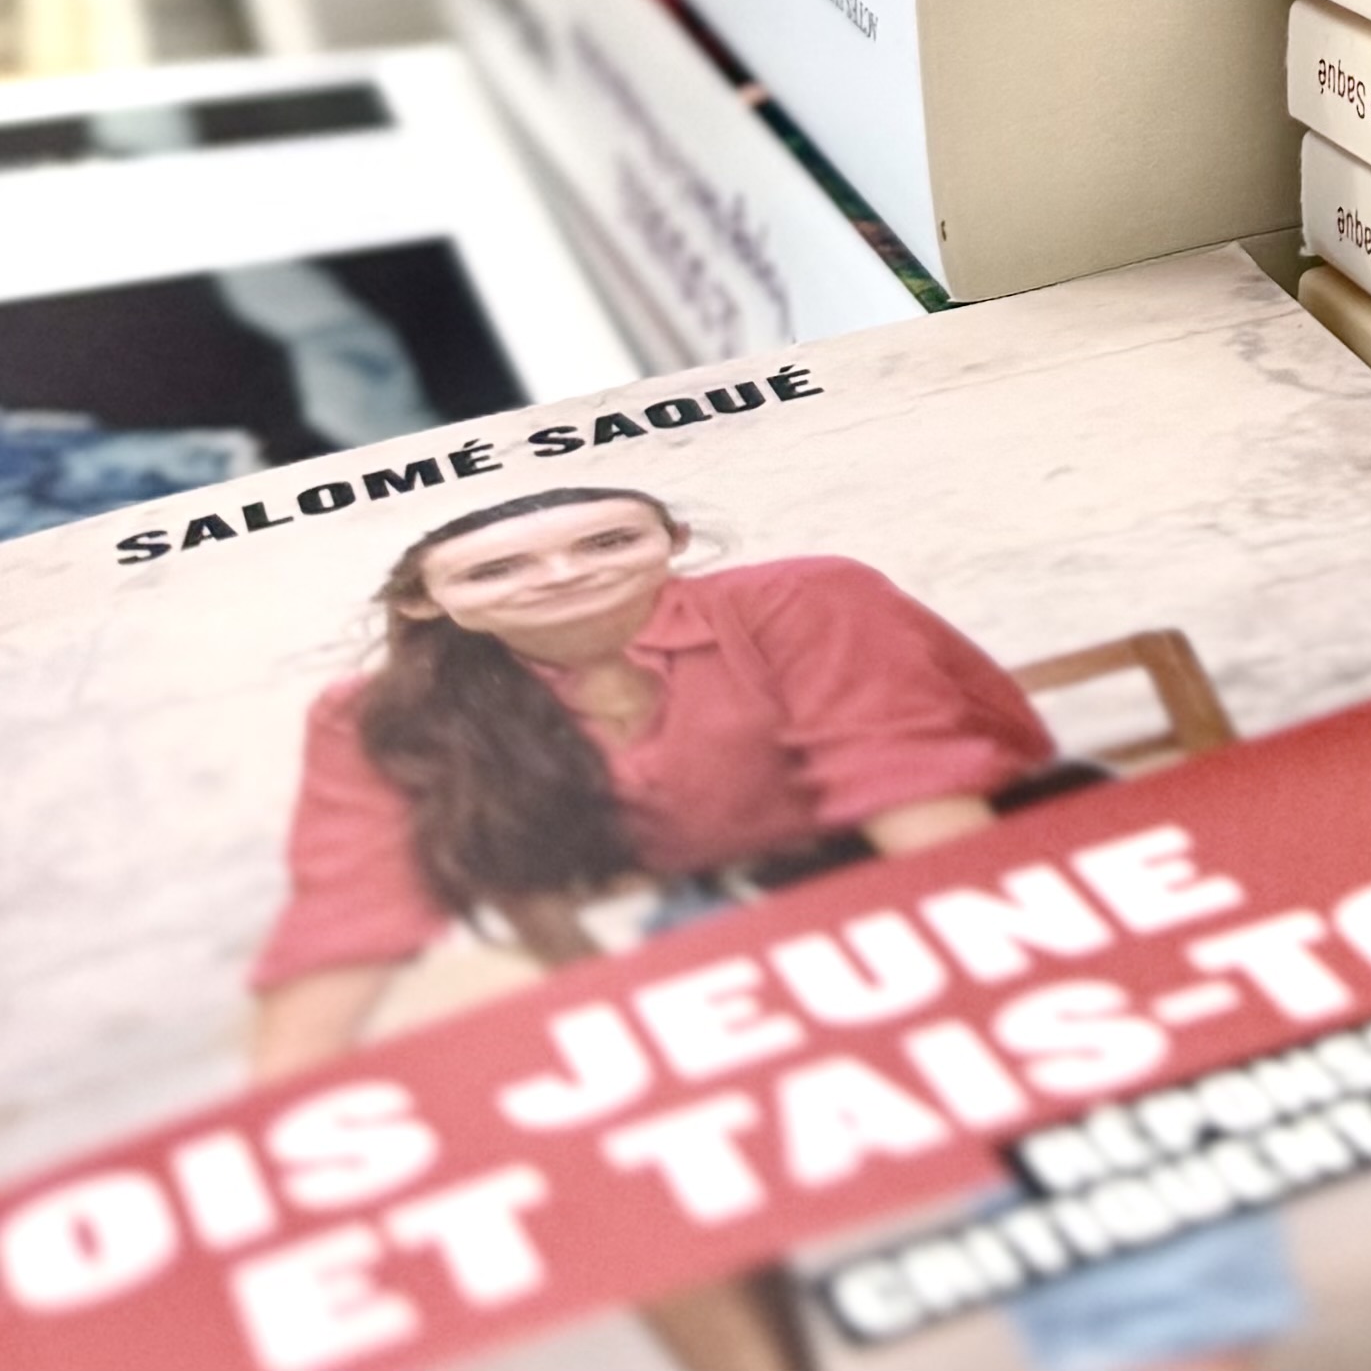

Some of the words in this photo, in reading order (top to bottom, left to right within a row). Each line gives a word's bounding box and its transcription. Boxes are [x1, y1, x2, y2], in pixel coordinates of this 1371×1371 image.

[1318, 58, 1366, 119] Saqué
[116, 438, 503, 566] SALOMÉ
[527, 363, 826, 458] SAQUÉ
[497, 821, 1249, 1133] JEUNE
[228, 1165, 552, 1371] ET
